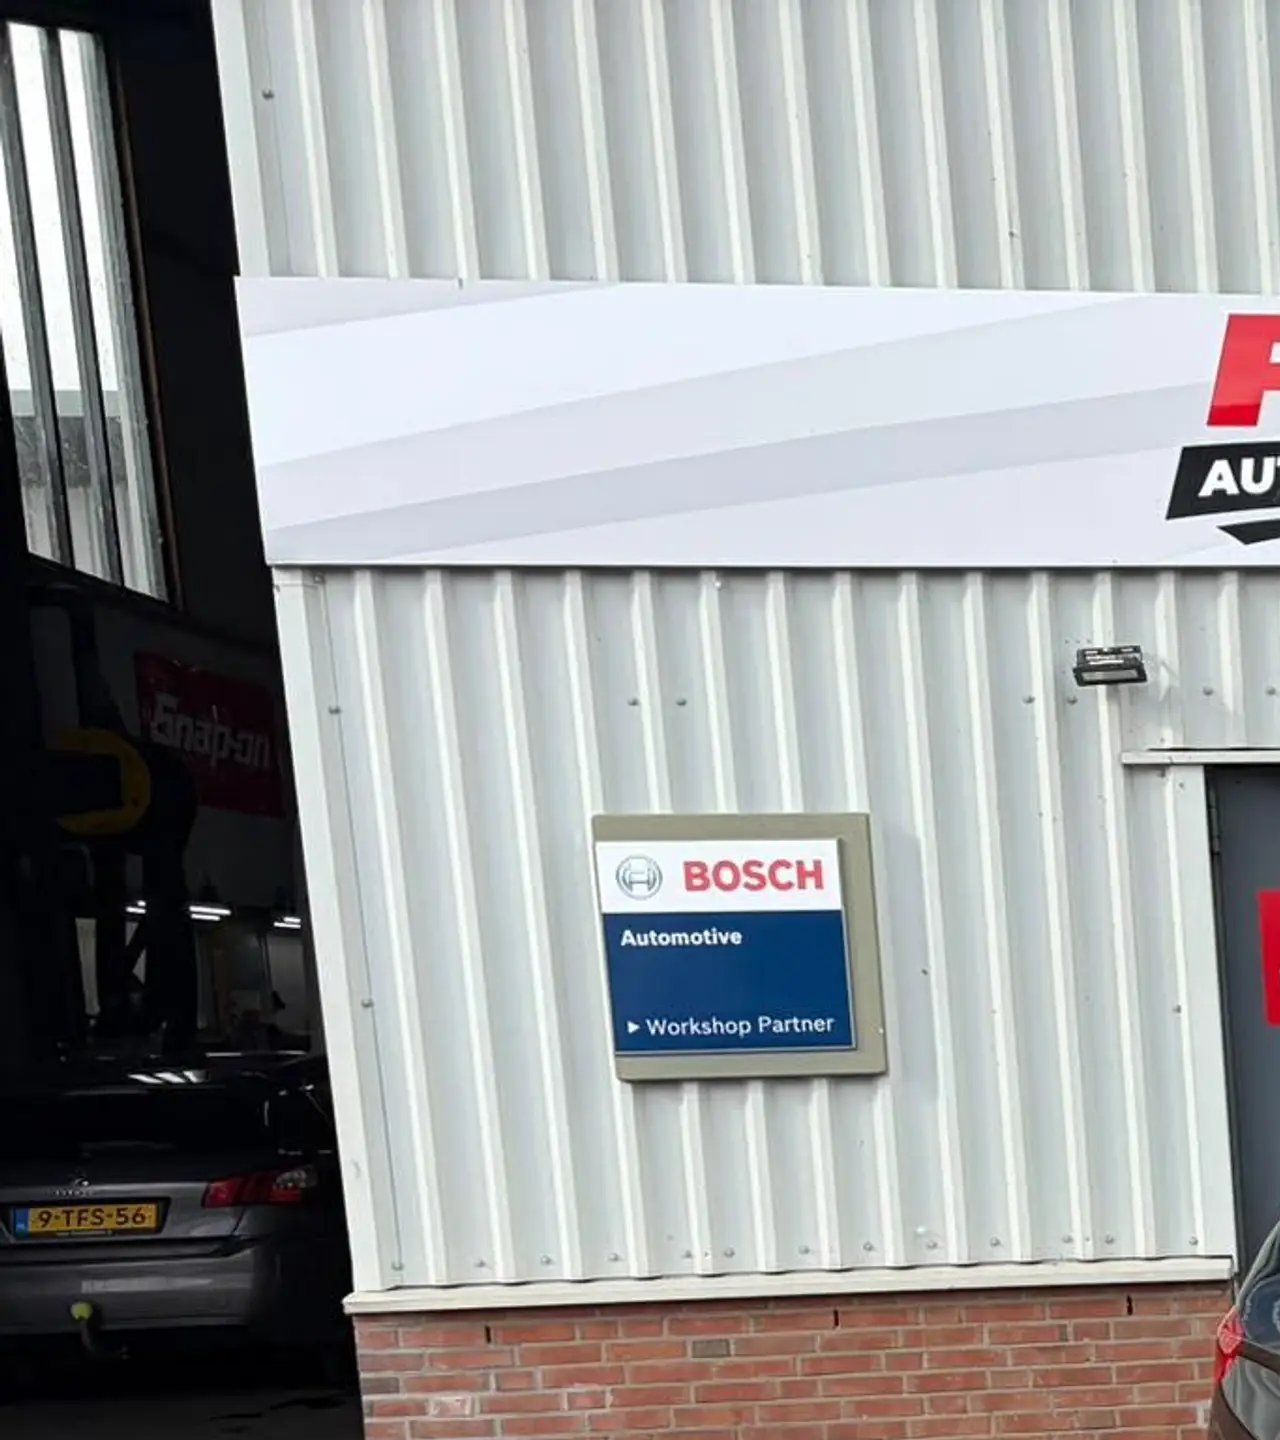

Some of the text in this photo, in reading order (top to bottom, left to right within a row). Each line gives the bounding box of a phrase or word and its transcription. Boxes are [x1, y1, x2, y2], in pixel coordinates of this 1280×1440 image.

[683, 859, 825, 892] BOSCH
[620, 927, 743, 947] Automotive
[645, 1015, 836, 1038] Workshop Partner
[37, 1206, 147, 1229] 9-TFS-56
